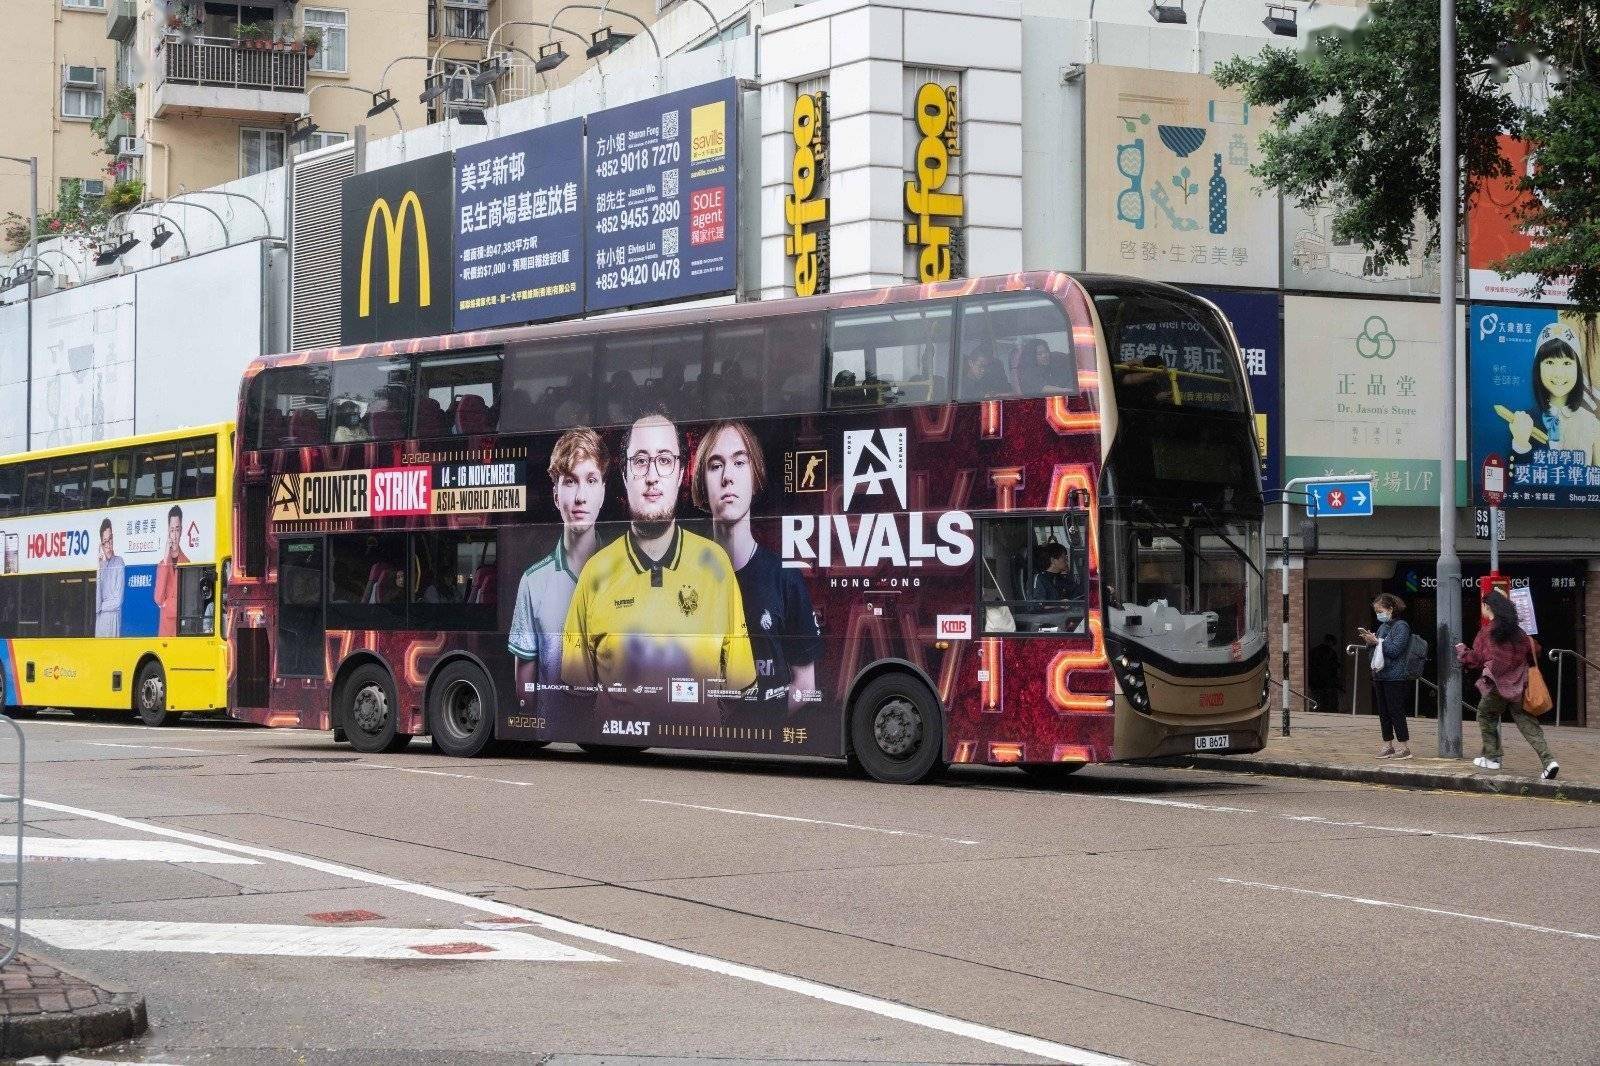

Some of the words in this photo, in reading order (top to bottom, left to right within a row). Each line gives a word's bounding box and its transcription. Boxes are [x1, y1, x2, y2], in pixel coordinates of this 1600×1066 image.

[596, 133, 626, 157] 方小姐
[693, 129, 723, 150] savills
[596, 158, 619, 178] +852
[620, 148, 649, 174] 9018
[651, 141, 680, 167] 7270
[461, 151, 525, 194] 美孚新邨
[596, 188, 626, 213] 胡先生
[628, 187, 646, 198] Jason
[692, 190, 721, 211] SOLE
[461, 181, 578, 235] 民生商場基座放售
[596, 215, 619, 234] +852
[620, 206, 649, 230] 9455
[651, 200, 680, 225] 2890
[692, 210, 723, 229] agent
[646, 241, 656, 252] Lin
[596, 246, 626, 270] 林小姐
[596, 272, 619, 291] +852
[620, 263, 649, 287] 9420
[651, 257, 680, 283] 0478
[1336, 372, 1417, 397] 正品堂
[1337, 403, 1353, 414] Dr.
[1356, 404, 1389, 415] Jason's
[1391, 405, 1417, 416] Store
[441, 466, 449, 487] 14
[457, 466, 467, 486] 16
[468, 463, 516, 485] NOVEMBER
[303, 473, 368, 514] COUNTER
[374, 469, 428, 512] STRIKE
[436, 490, 489, 511] ASIA-WORLD
[491, 488, 521, 510] ARENA
[1569, 493, 1587, 502] Shop
[1476, 509, 1489, 523] SS
[781, 510, 975, 569] RIVALS
[1476, 524, 1489, 537] 319
[27, 529, 90, 559] HOUSE730
[830, 578, 870, 588] HONG
[1421, 576, 1473, 588] stard
[941, 620, 967, 634] KMB
[610, 720, 651, 736] BLAST
[782, 727, 808, 744] 對手
[1196, 738, 1207, 749] UB
[1209, 736, 1228, 748] 8627
